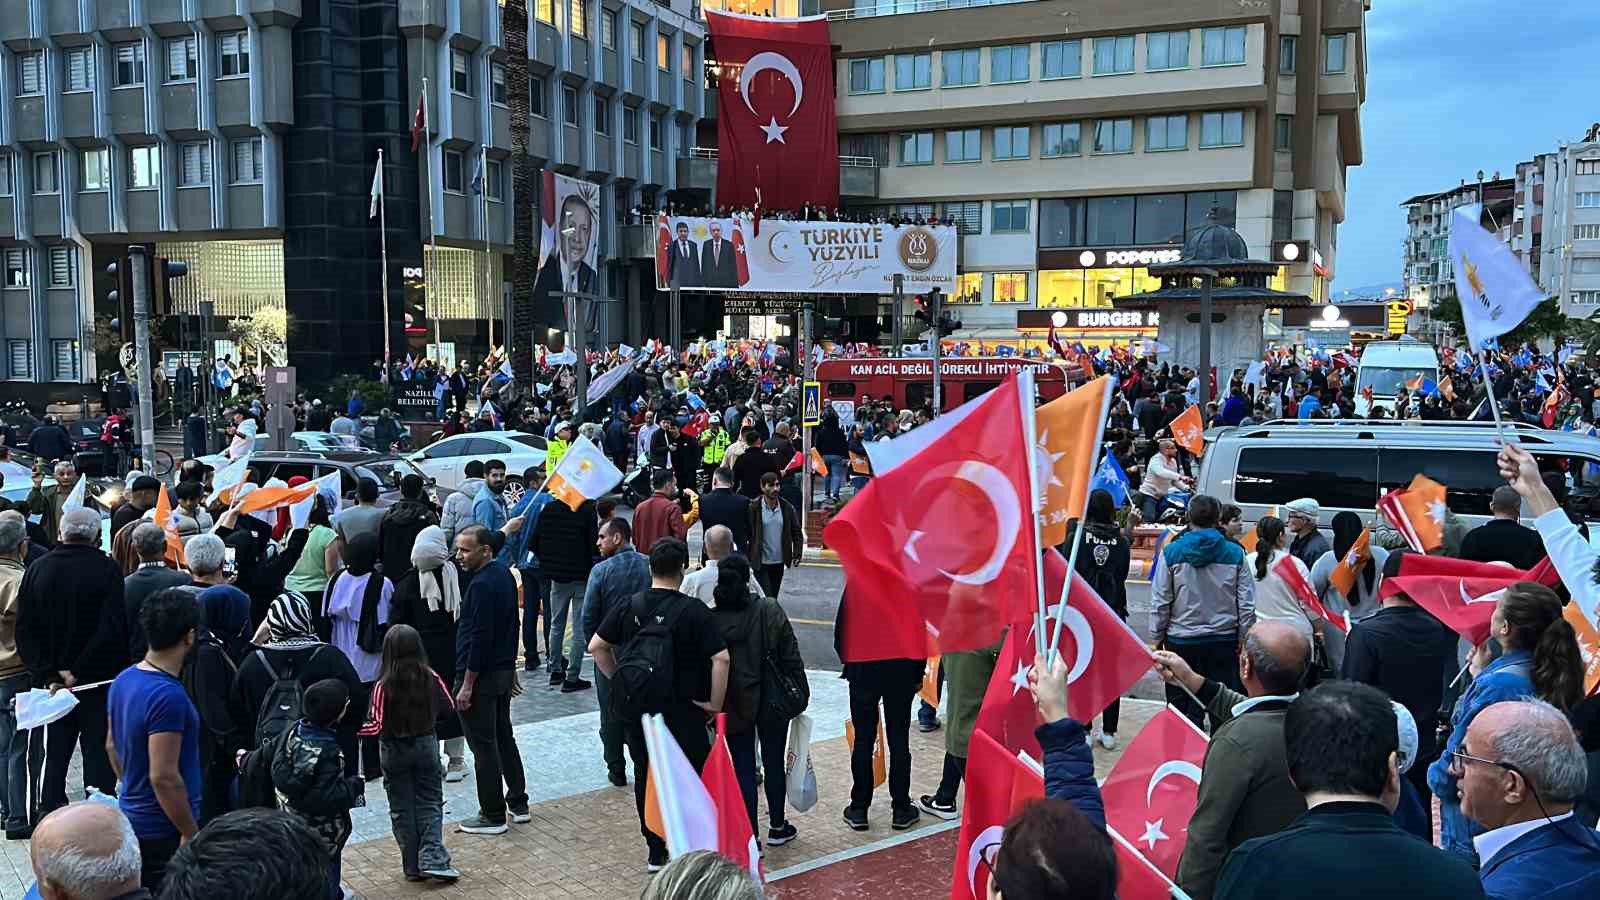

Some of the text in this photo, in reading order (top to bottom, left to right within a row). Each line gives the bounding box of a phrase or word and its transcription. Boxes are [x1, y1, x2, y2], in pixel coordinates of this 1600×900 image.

[800, 227, 883, 246] TÜRKİYE
[1078, 312, 1160, 327] BURGER K
[850, 364, 873, 375] KAN
[875, 362, 898, 375] ACİL
[901, 362, 932, 375] DEĞİL
